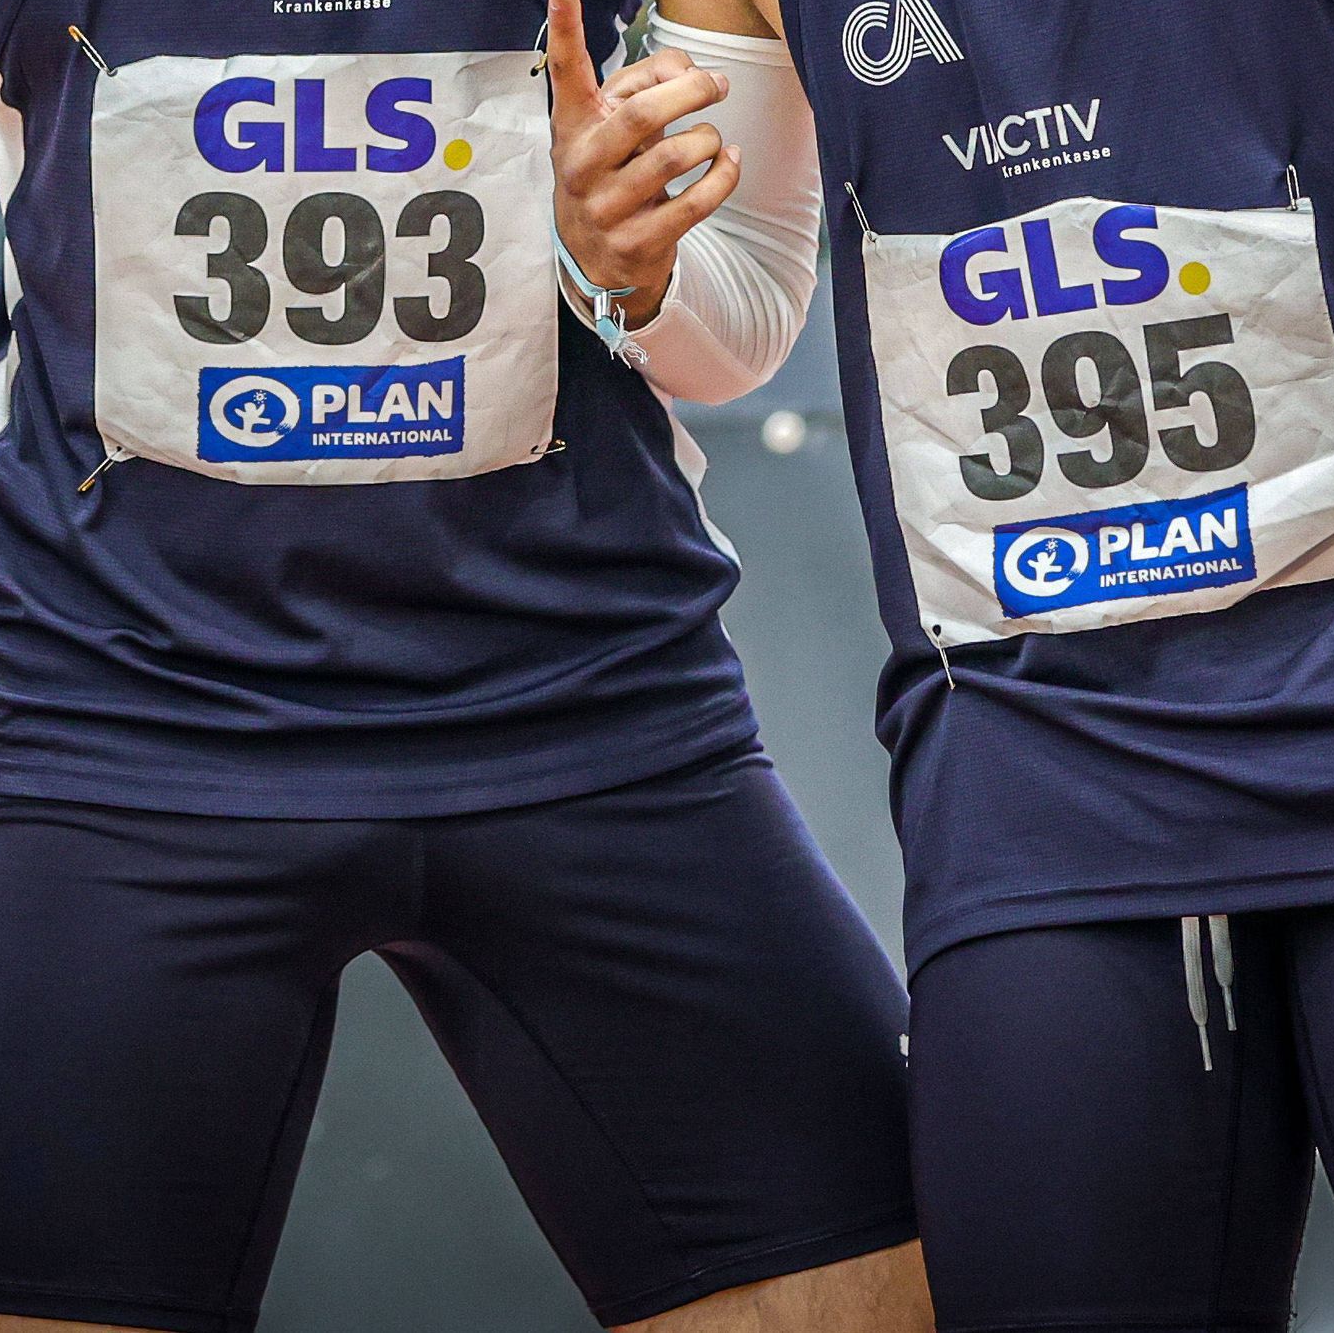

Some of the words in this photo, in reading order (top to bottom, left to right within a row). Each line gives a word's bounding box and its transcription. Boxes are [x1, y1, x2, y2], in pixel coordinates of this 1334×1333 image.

[1002, 146, 1111, 178] Krankenkasse
[173, 190, 486, 345] 393
[312, 379, 453, 424] PLAN
[945, 312, 1256, 502] 395
[312, 428, 453, 446] INTERNATIONAL
[1097, 507, 1238, 565] PLAN
[1099, 557, 1244, 588] INTERNATIONAL
